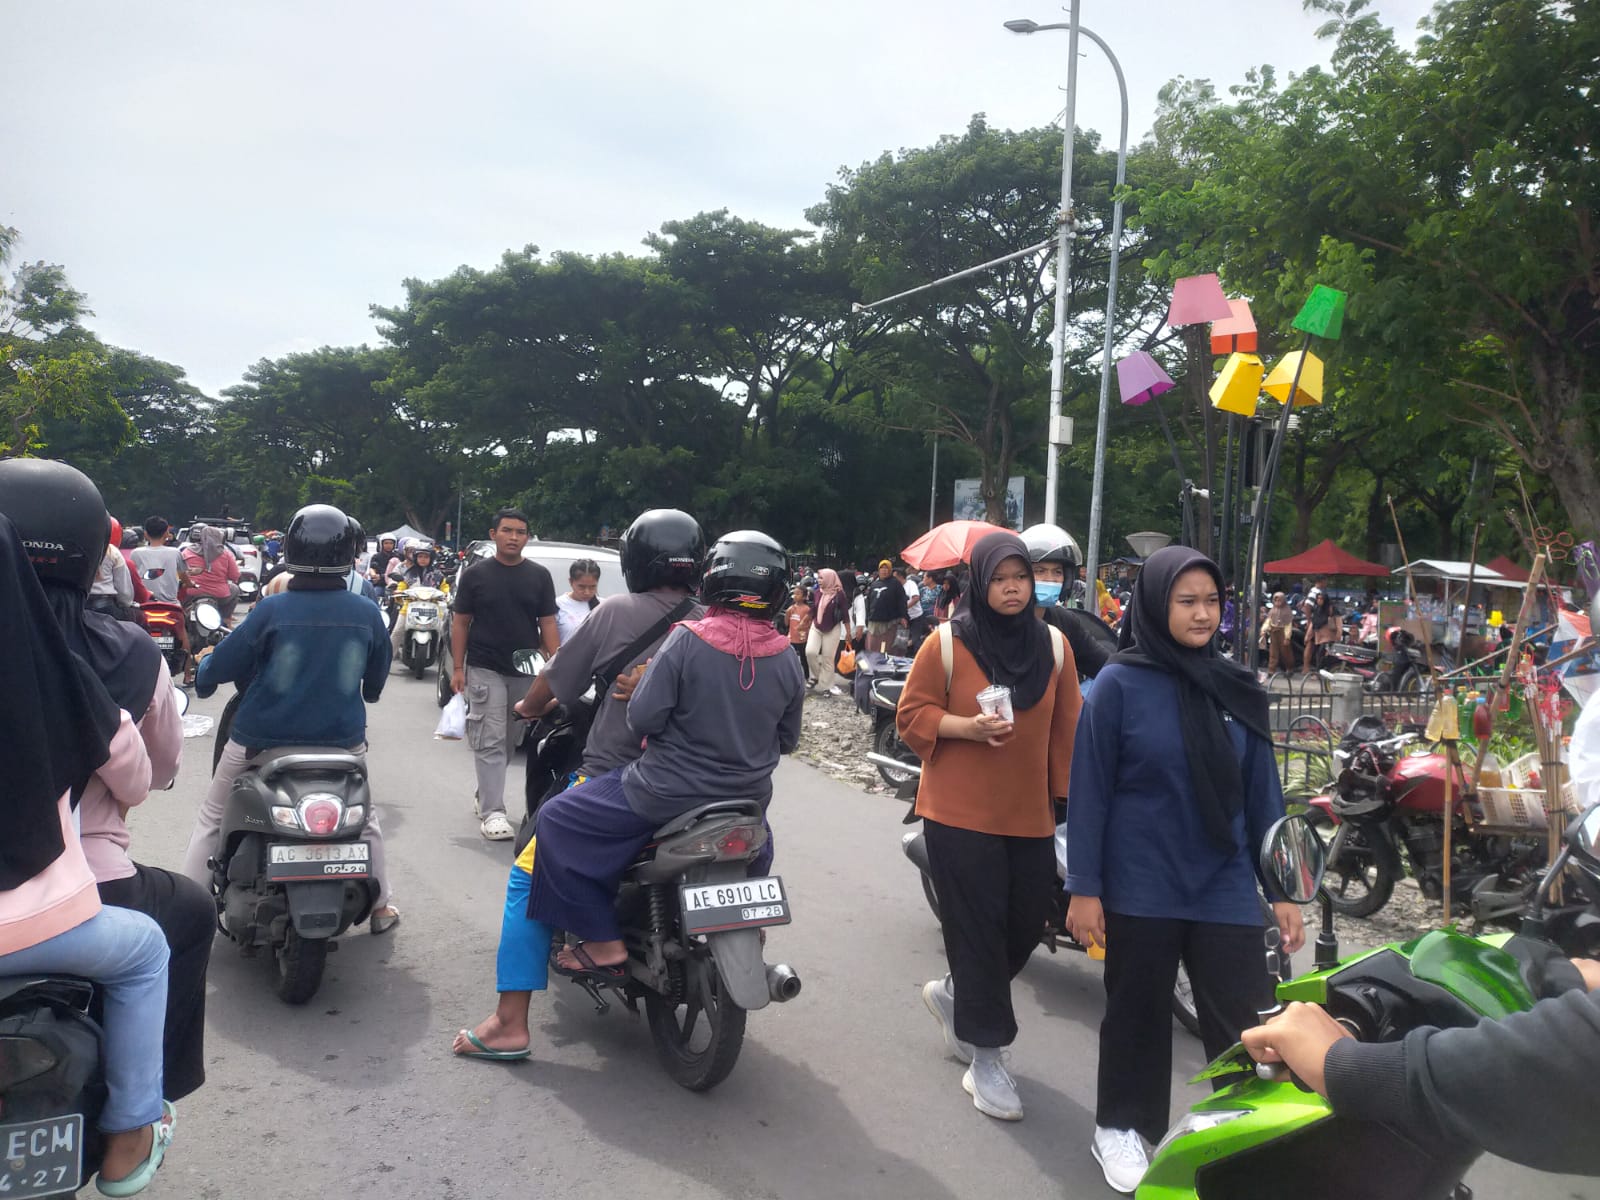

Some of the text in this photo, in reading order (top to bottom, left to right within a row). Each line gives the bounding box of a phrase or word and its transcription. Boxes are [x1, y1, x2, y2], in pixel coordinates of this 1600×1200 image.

[22, 540, 65, 551] ONDA
[305, 847, 342, 861] 3613
[348, 844, 366, 860] AX
[693, 883, 776, 909] AE 6910 LC
[6, 1122, 74, 1160] ECM
